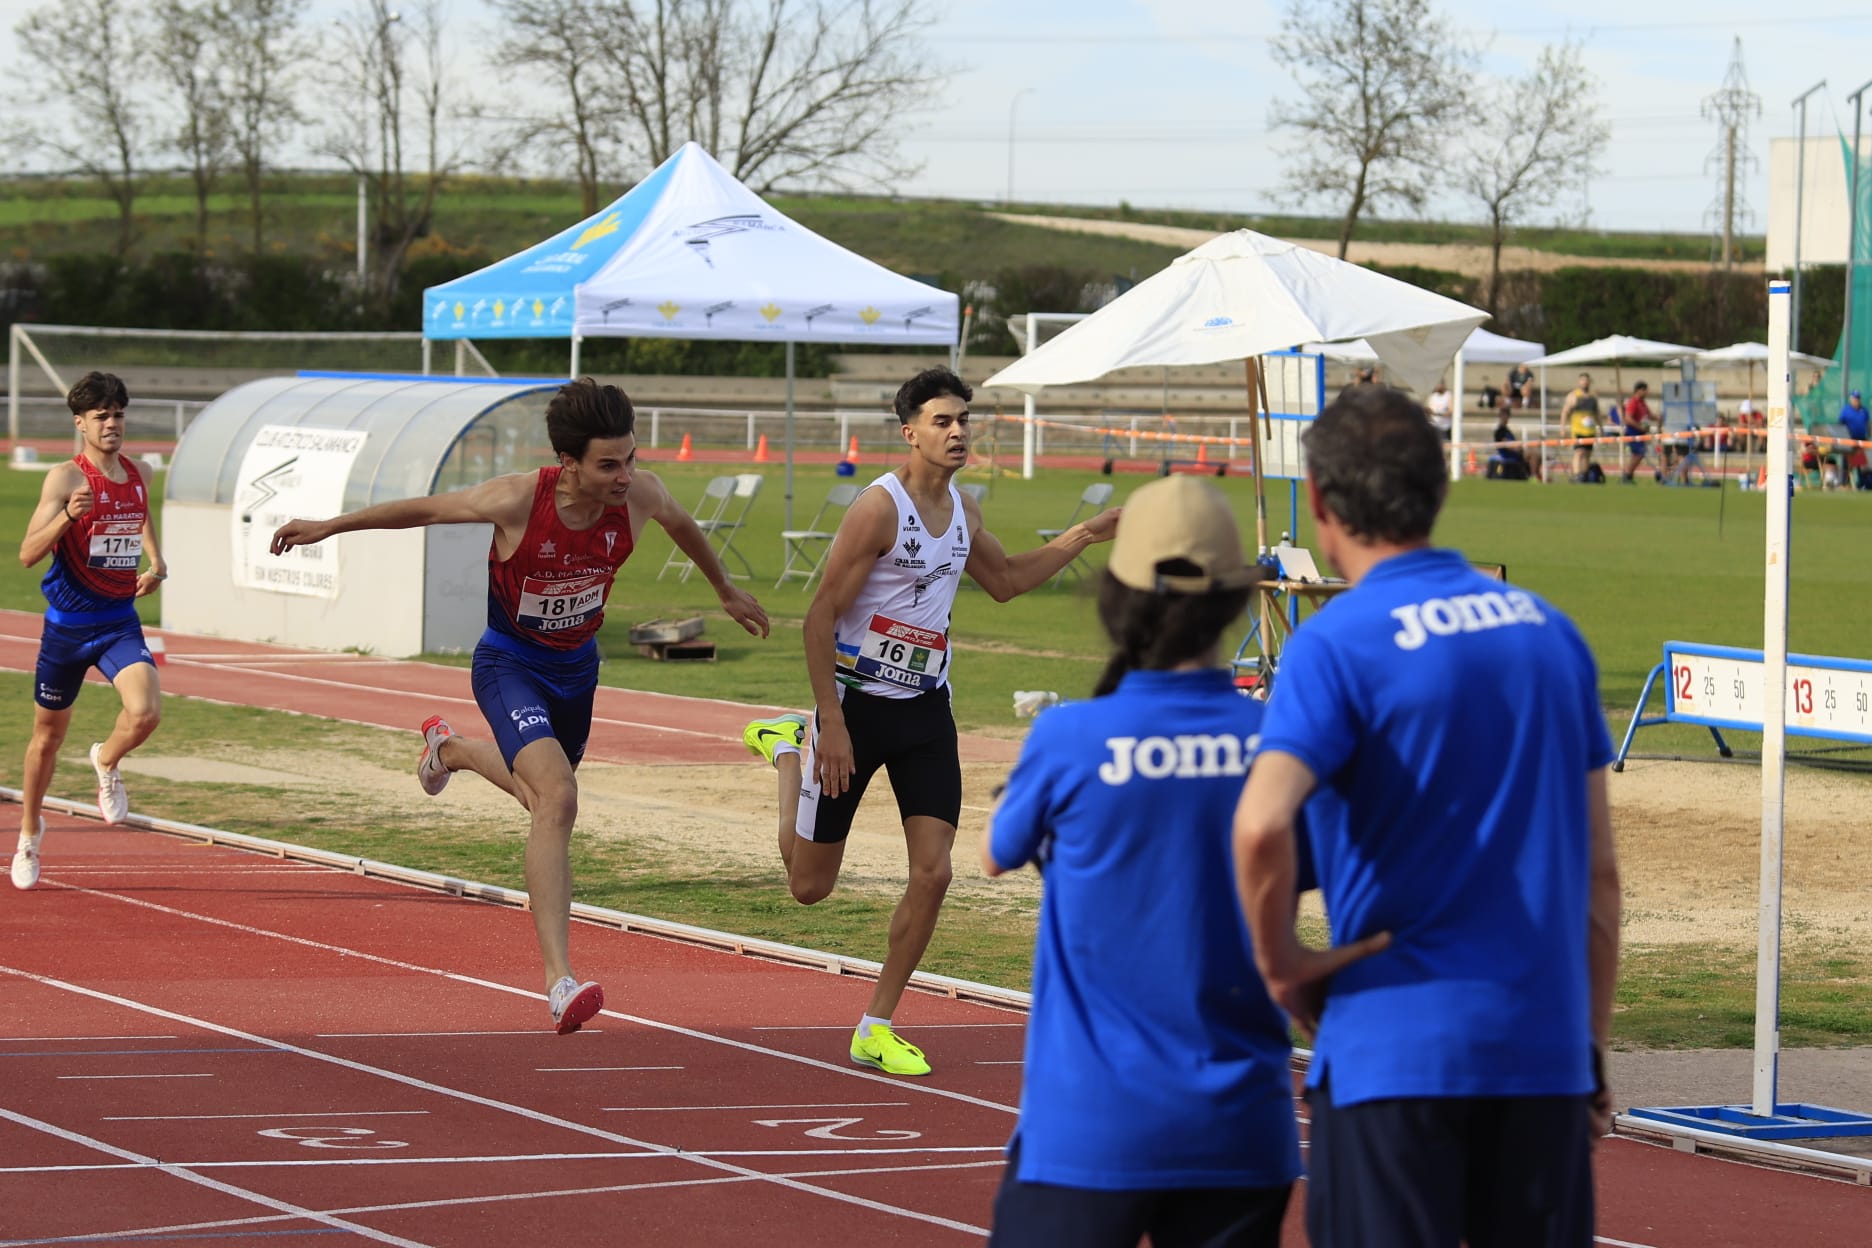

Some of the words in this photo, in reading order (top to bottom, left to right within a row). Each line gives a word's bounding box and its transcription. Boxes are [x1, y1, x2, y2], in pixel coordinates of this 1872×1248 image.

[103, 537, 122, 553] 17
[103, 556, 137, 568] Joma
[538, 598, 566, 616] 18
[577, 588, 600, 606] ADM
[538, 614, 585, 631] Joma
[1390, 590, 1547, 651] Joma
[878, 639, 906, 663] 16
[875, 663, 921, 687] Joma
[1673, 664, 1693, 700] 12
[1704, 676, 1715, 696] 25
[1733, 679, 1745, 700] 50
[1793, 678, 1813, 714] 13
[1824, 689, 1837, 709] 25
[1856, 692, 1868, 712] 50
[257, 1126, 410, 1149] 3
[750, 1117, 922, 1141] 2
